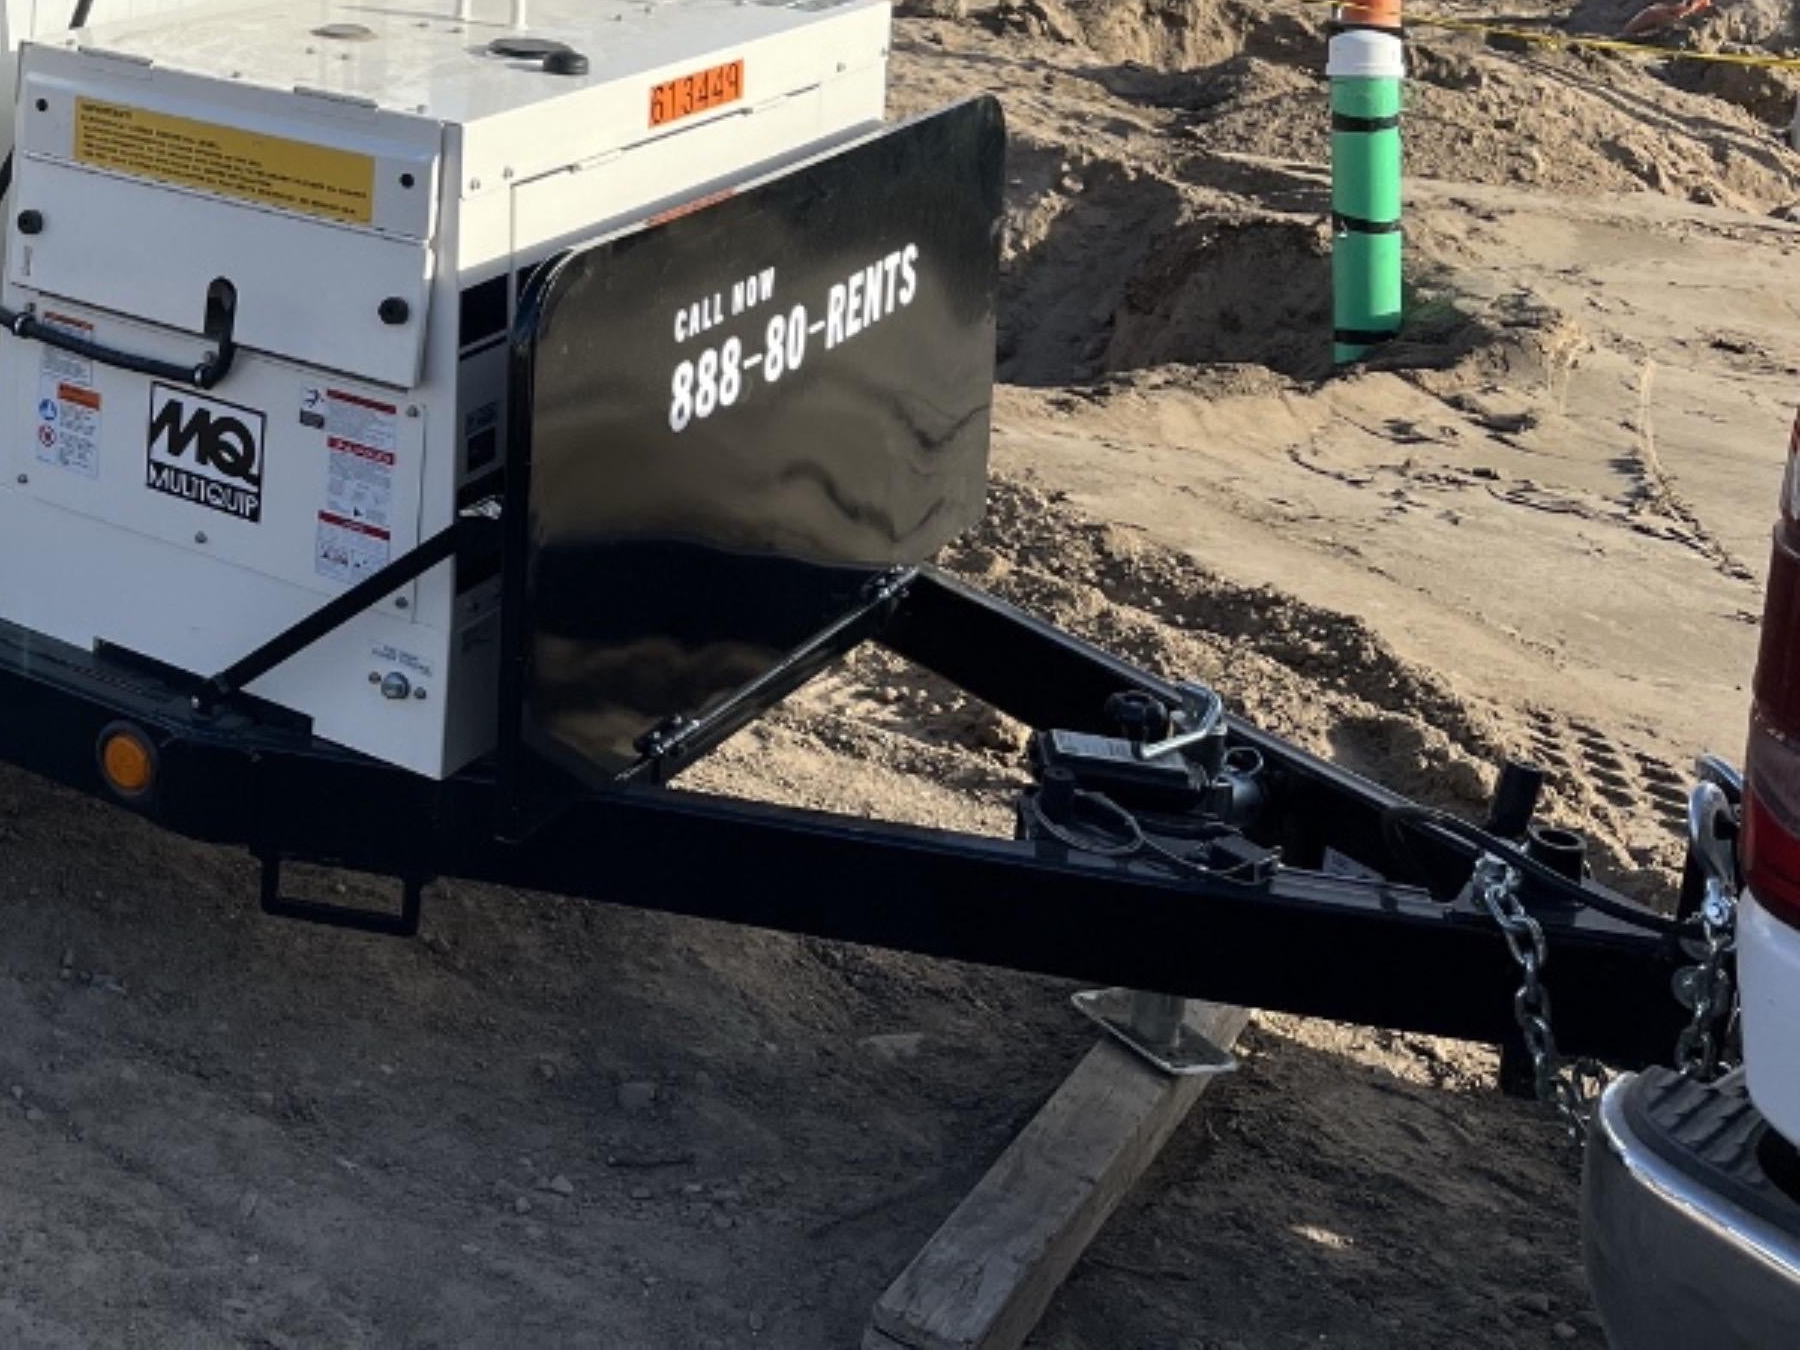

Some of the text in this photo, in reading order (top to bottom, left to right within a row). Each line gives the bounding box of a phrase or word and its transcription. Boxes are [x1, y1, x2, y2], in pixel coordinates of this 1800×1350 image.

[650, 61, 741, 126] 613449
[668, 243, 919, 433] 888-80-RENTS
[674, 266, 776, 343] CALL NOW
[149, 398, 261, 486] MQ
[149, 463, 259, 518] MULTIQUIP
